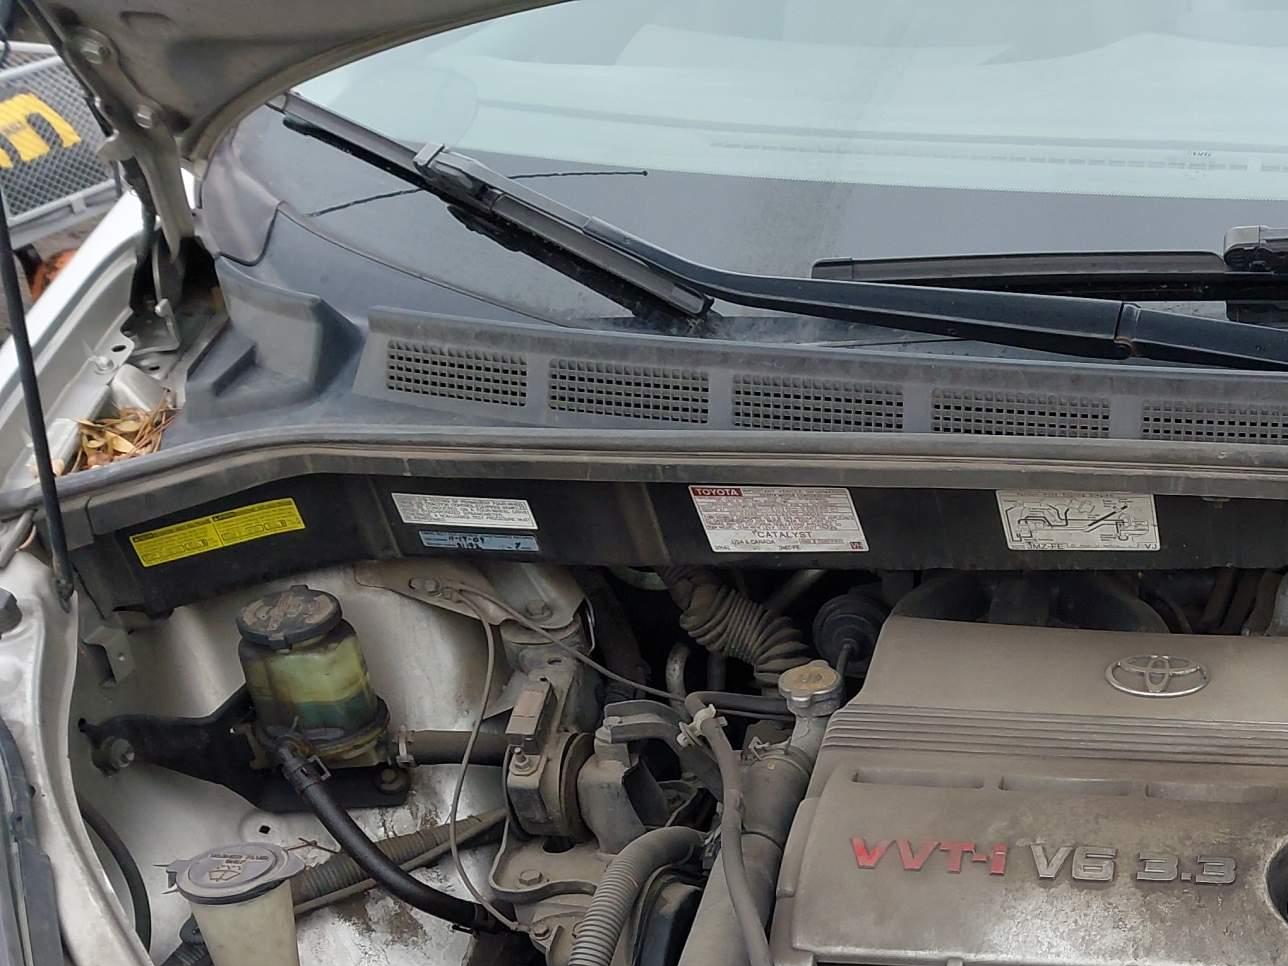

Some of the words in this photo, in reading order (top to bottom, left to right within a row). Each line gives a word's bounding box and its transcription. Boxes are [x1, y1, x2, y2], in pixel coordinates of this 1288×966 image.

[696, 488, 740, 496] TOYOTA
[757, 531, 813, 539] CATALYST
[850, 837, 1009, 876] VVT-i
[1030, 845, 1118, 882] V6
[1136, 852, 1238, 885] 3.3
